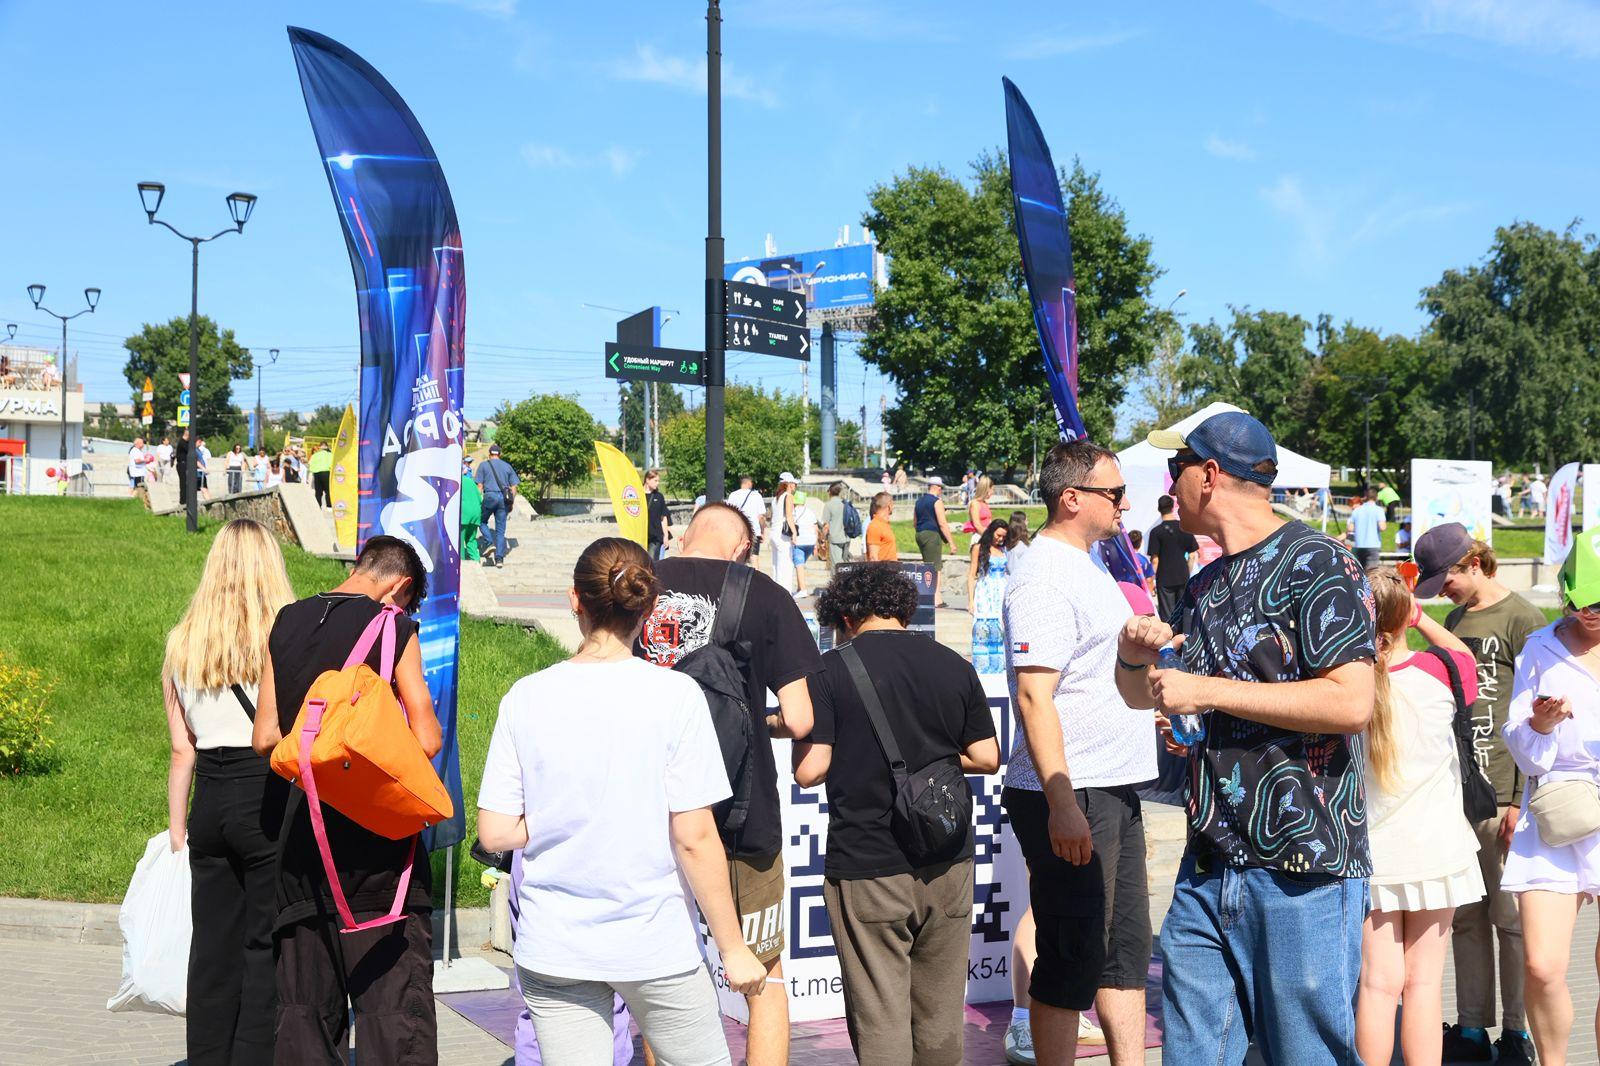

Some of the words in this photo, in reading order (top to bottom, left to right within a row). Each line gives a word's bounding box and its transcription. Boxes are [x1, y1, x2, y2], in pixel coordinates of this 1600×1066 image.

[623, 363, 650, 371] Convenient
[650, 358, 675, 367] МАРШРУТ
[1470, 704, 1494, 772] TRUE
[967, 956, 1008, 981] k54
